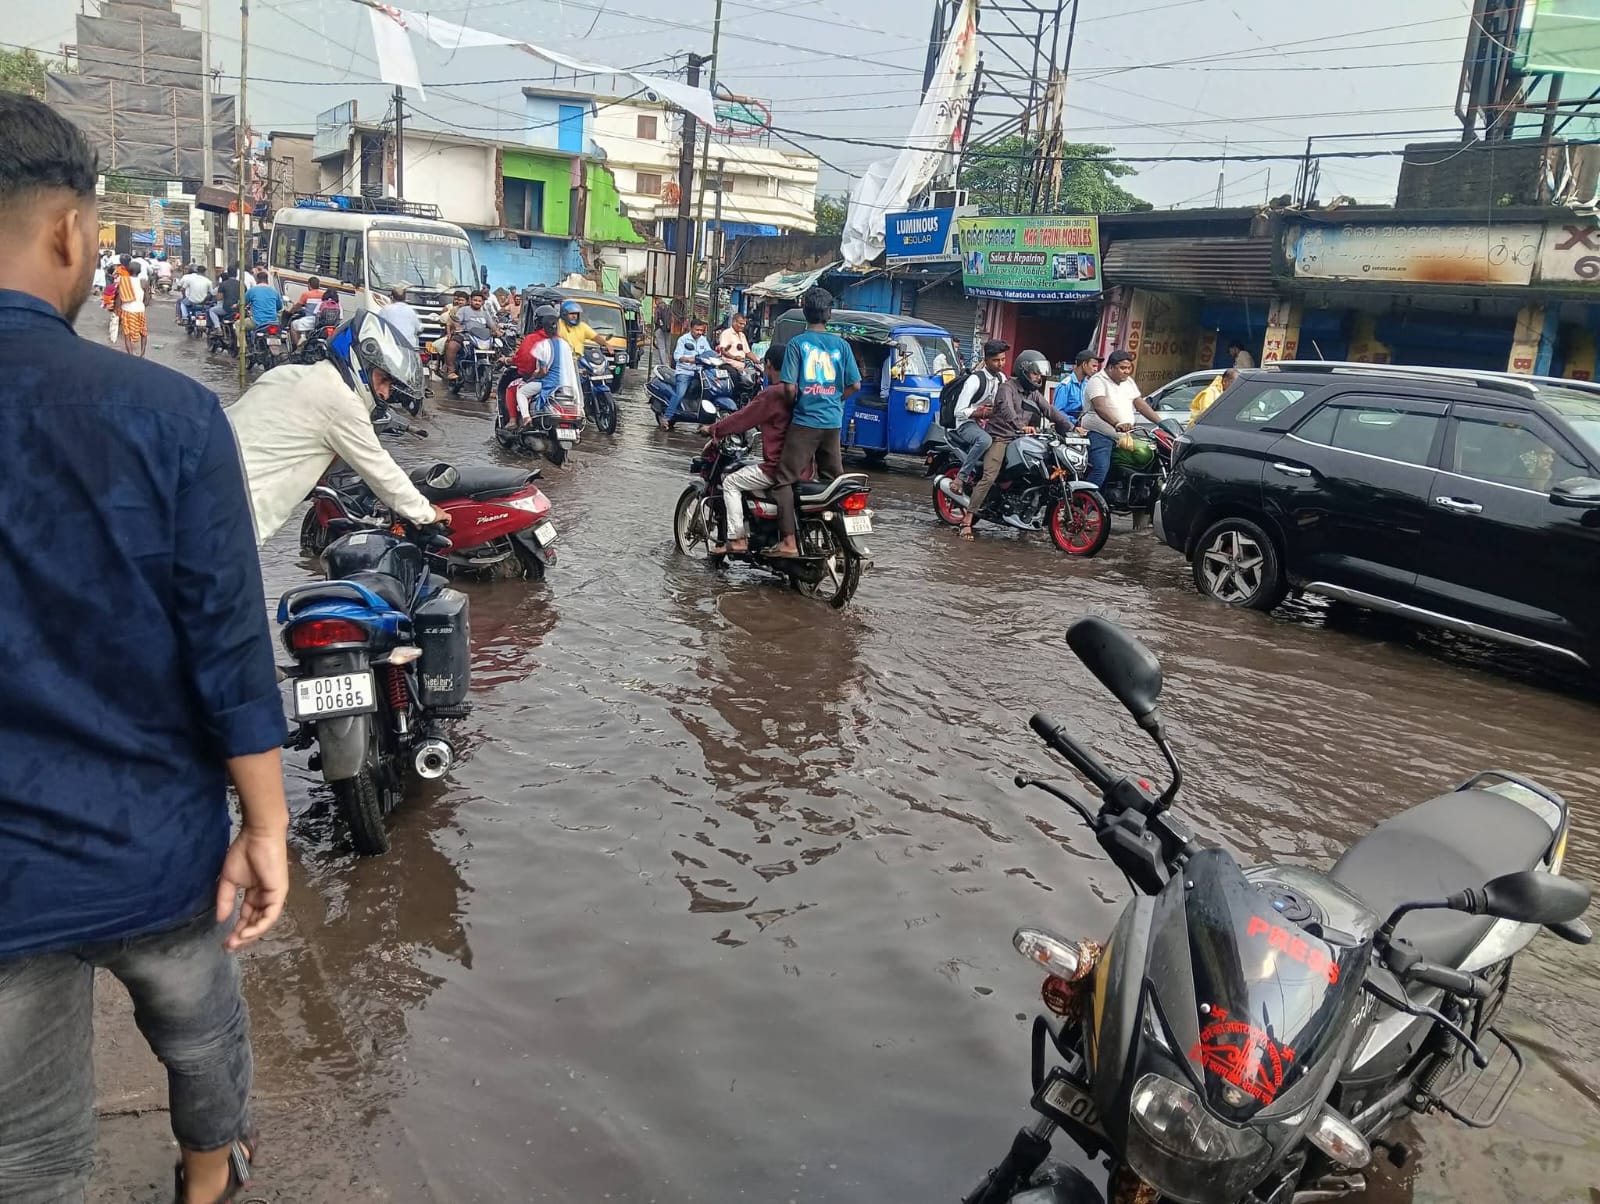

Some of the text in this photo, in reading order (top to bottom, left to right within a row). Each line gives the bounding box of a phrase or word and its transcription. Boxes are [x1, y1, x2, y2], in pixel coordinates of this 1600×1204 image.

[896, 216, 938, 235] LUMINOUS
[1061, 227, 1093, 248] MOBILES
[990, 252, 1006, 262] Sales
[1014, 252, 1045, 265] Repairing
[315, 676, 352, 695] OD19
[316, 691, 364, 711] D0685
[1247, 916, 1341, 984] PRESS
